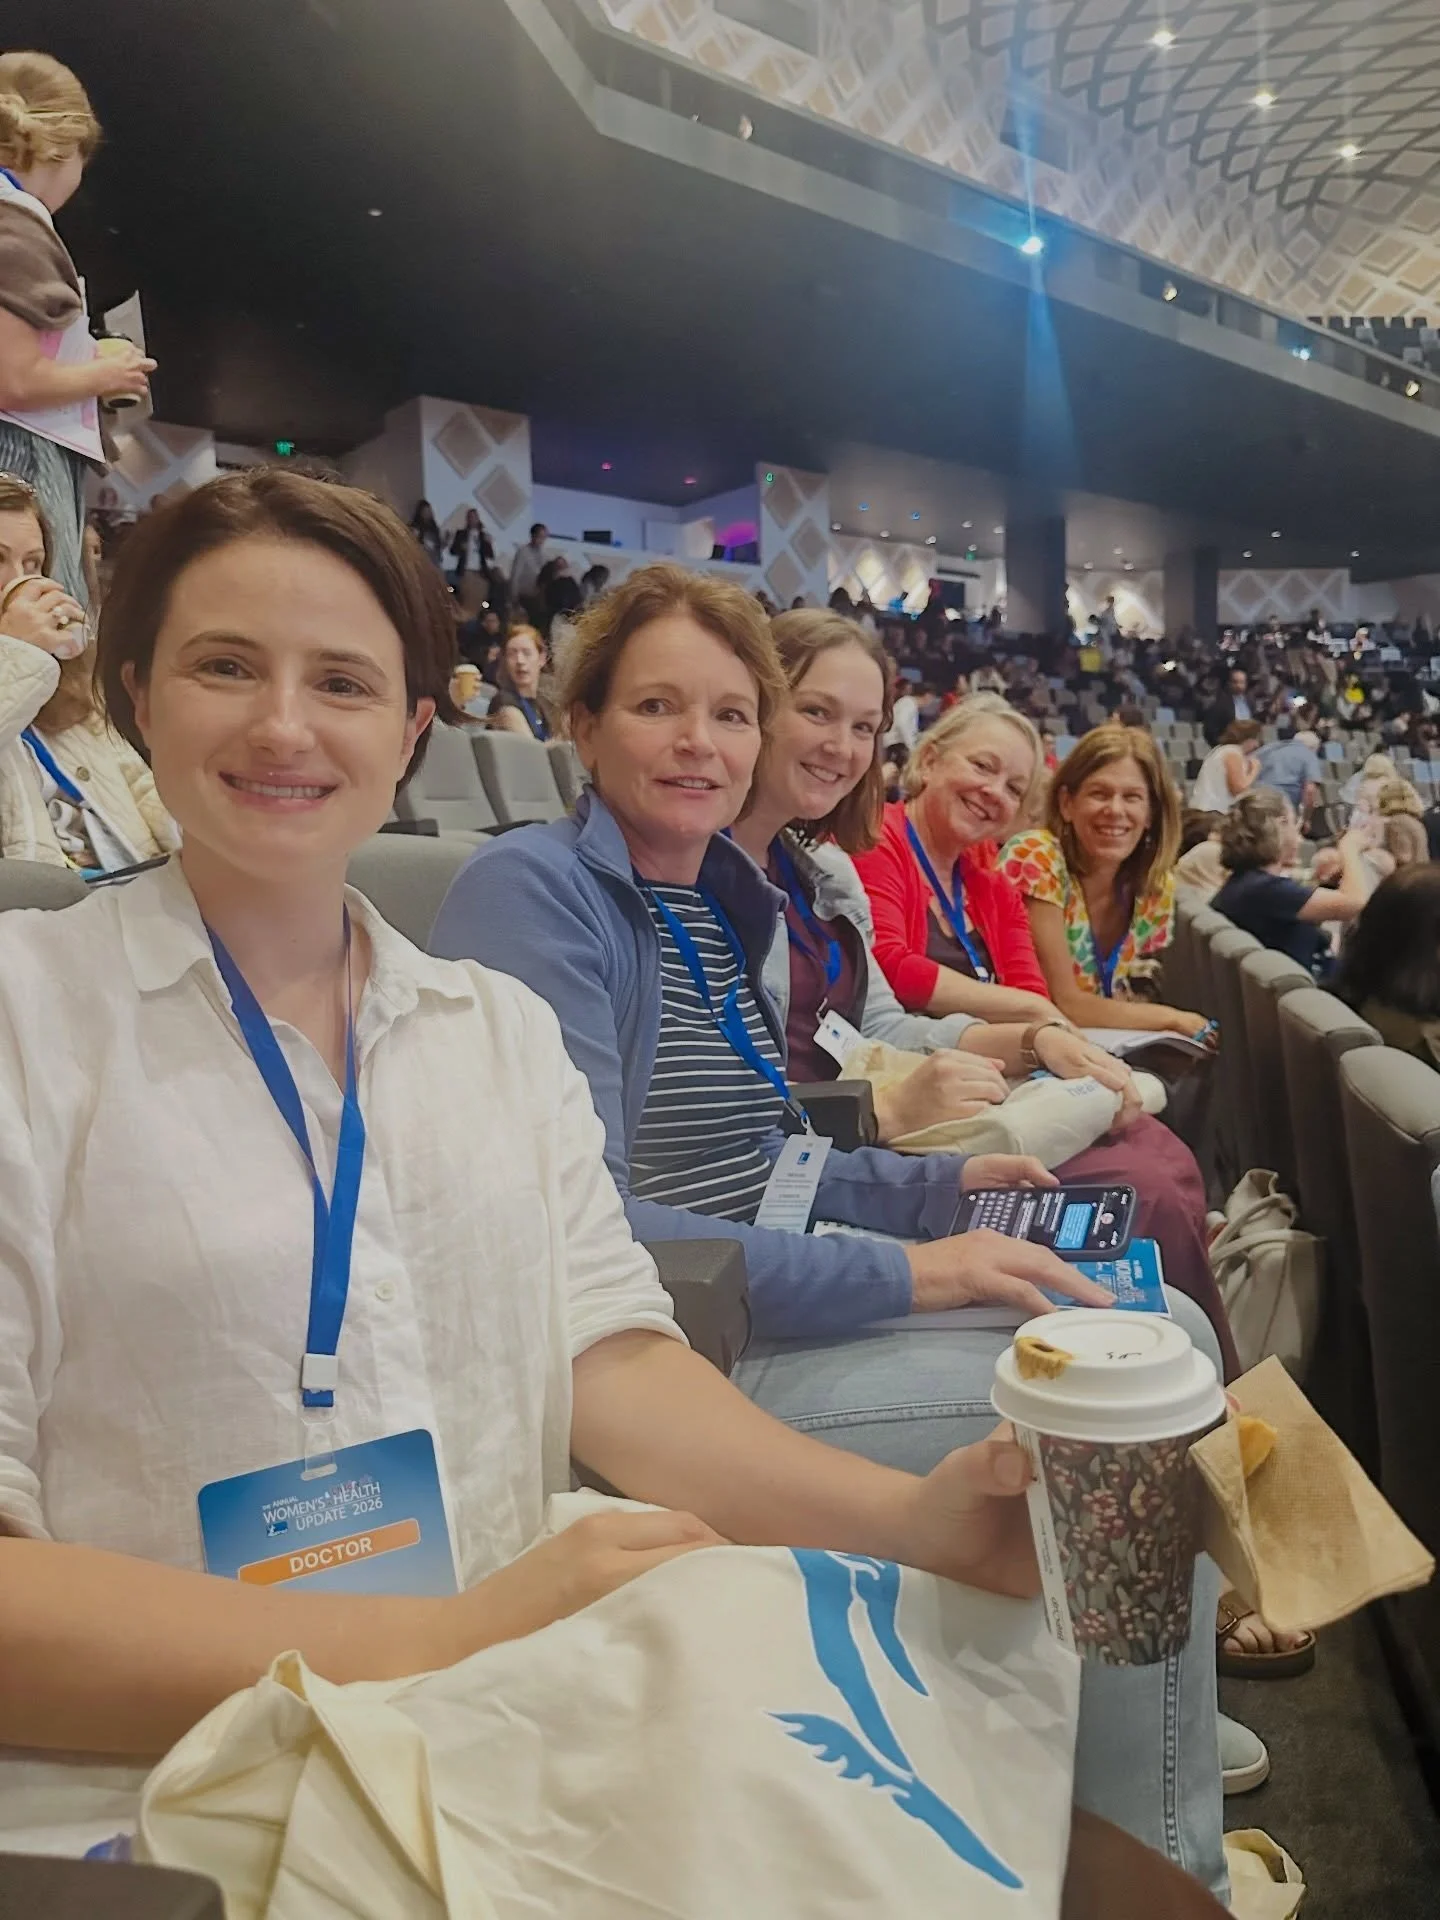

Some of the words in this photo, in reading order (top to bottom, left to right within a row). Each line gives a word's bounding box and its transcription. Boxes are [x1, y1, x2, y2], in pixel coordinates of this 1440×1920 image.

[263, 1496, 326, 1523] WOMEN'S
[332, 1481, 381, 1505] HEALTH
[272, 1495, 299, 1508] ANNUAL
[296, 1506, 347, 1531] UPDATE
[352, 1497, 383, 1516] 2026
[289, 1537, 373, 1573] DOCTOR
